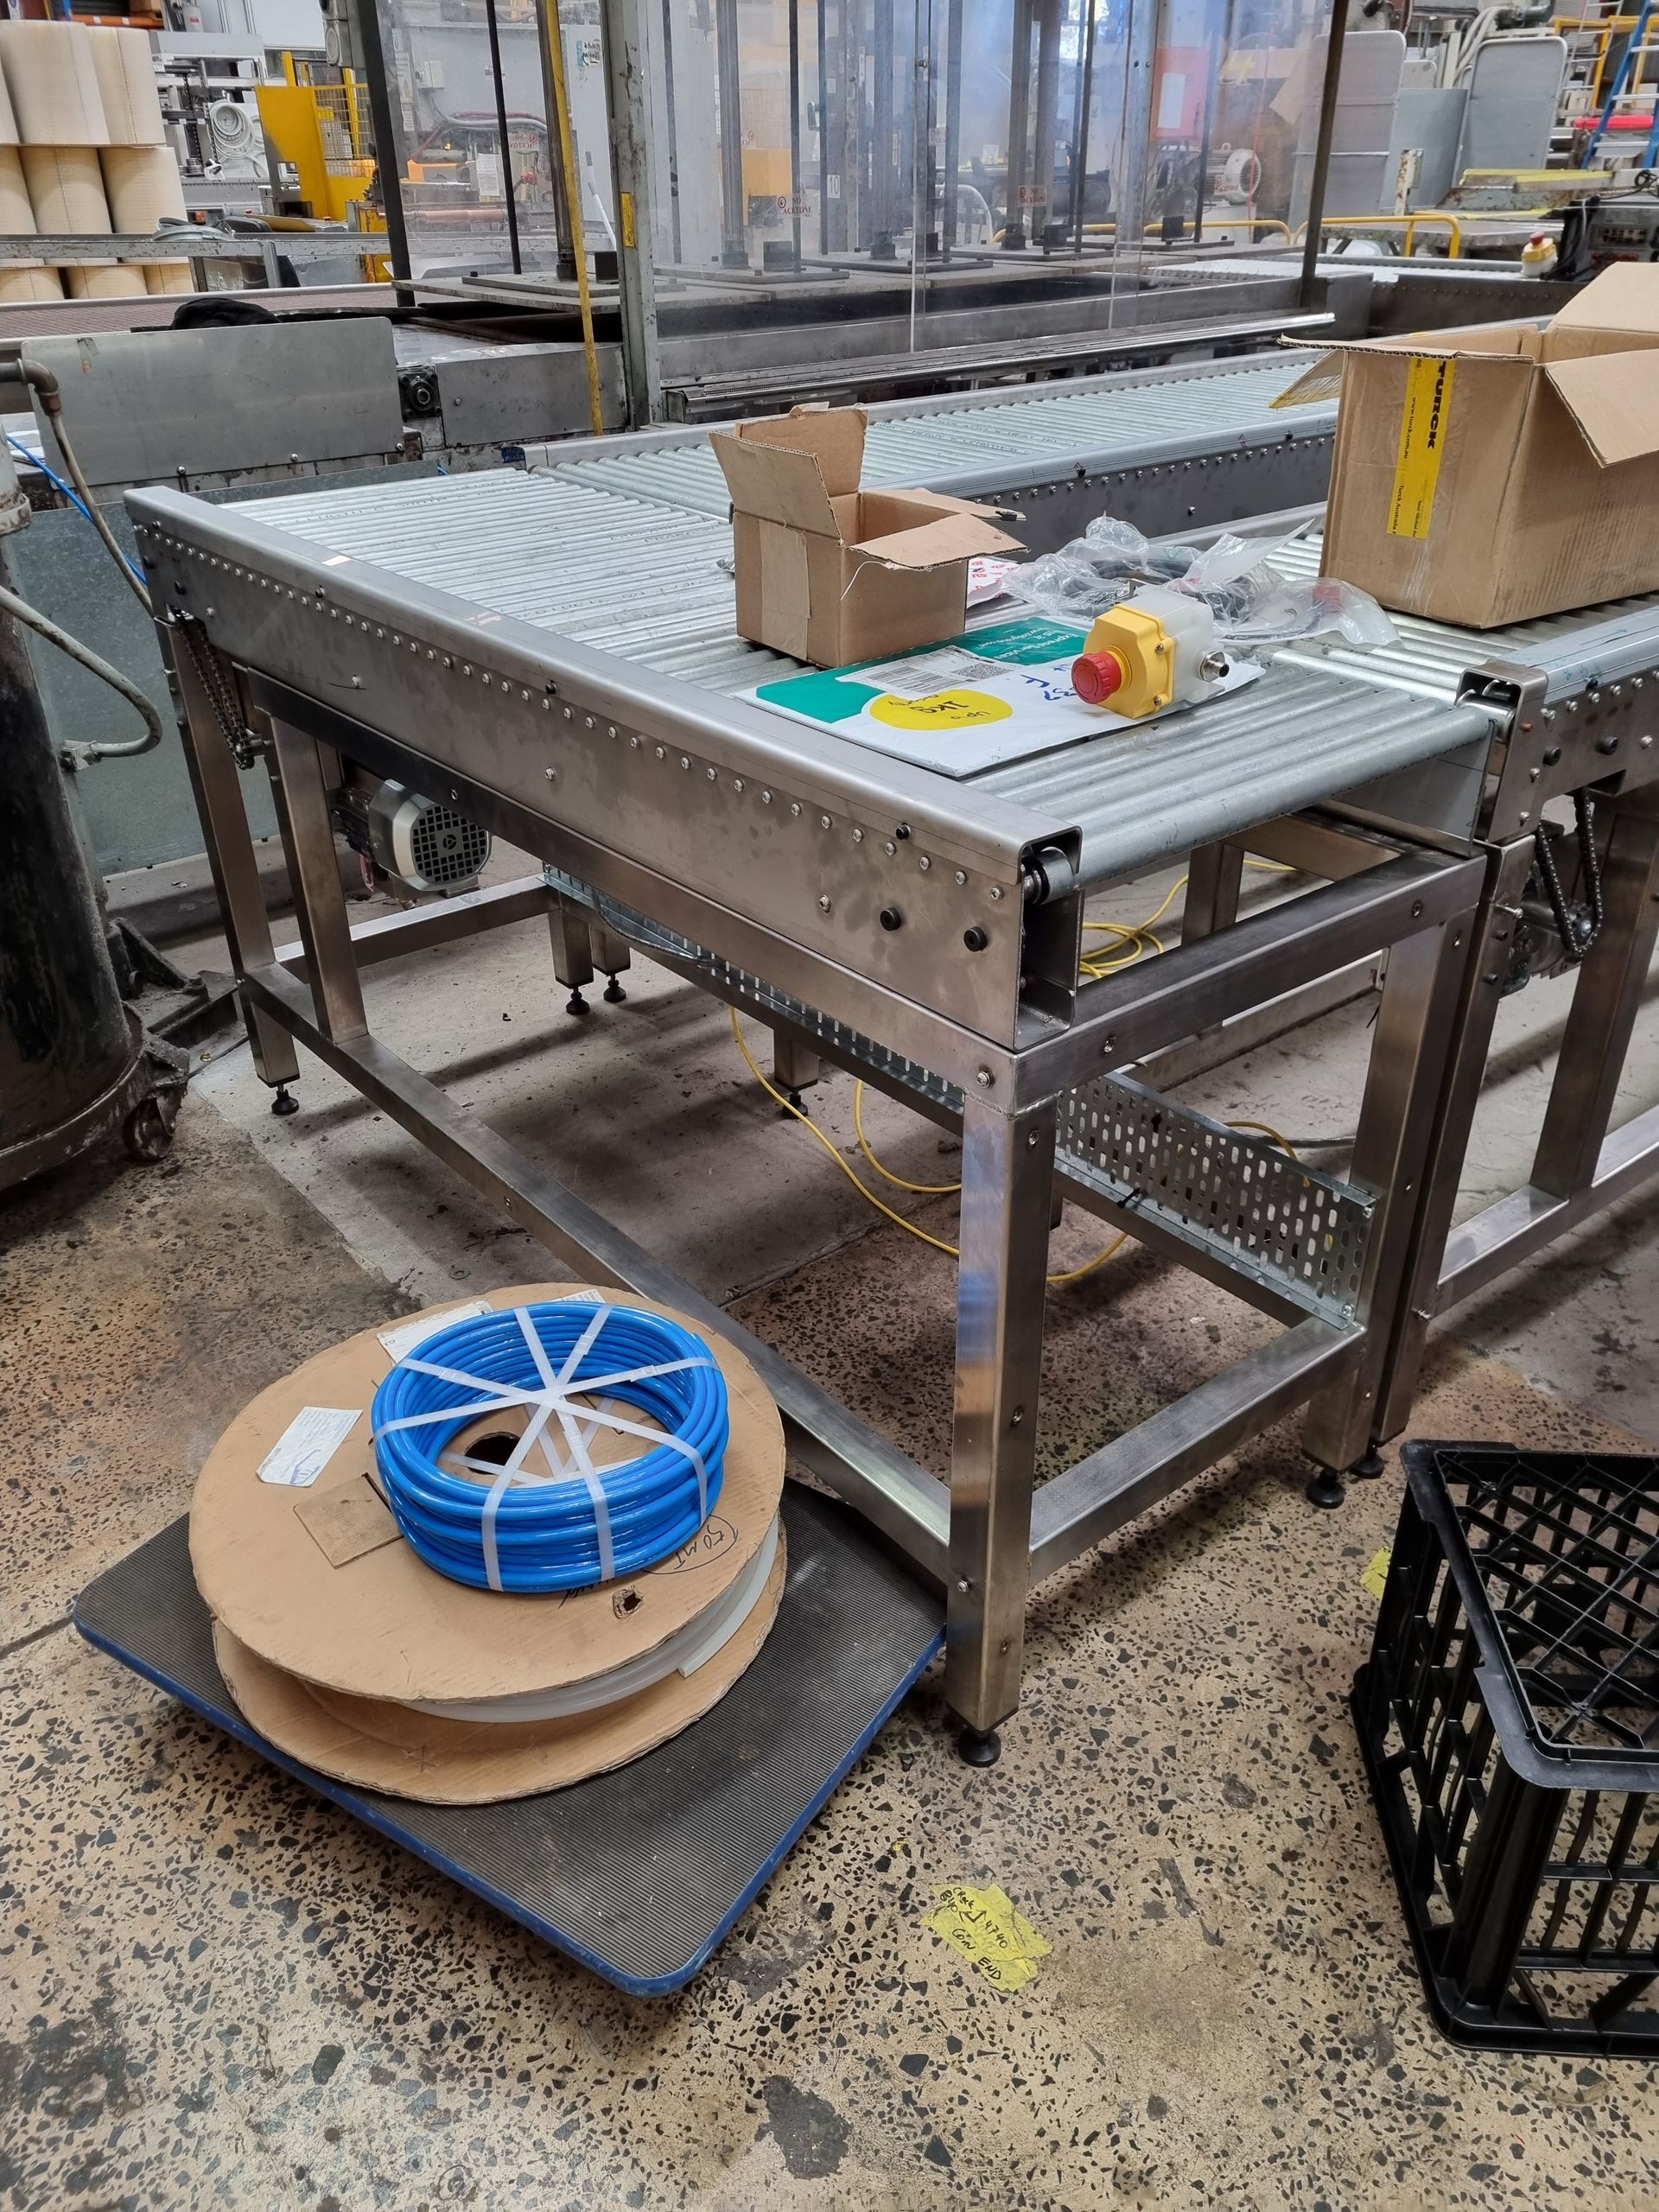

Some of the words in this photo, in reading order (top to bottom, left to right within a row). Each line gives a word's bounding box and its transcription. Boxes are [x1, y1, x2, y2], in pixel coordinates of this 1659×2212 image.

[830, 176, 839, 194] 10
[783, 207, 813, 215] ACETONE
[1427, 361, 1447, 450] TURCK
[1403, 397, 1417, 460] www.turck.com.au
[1392, 502, 1402, 530] Australia
[910, 701, 969, 715] 1kg
[984, 1920, 1008, 1949] 4740
[978, 1957, 1001, 1980] END
